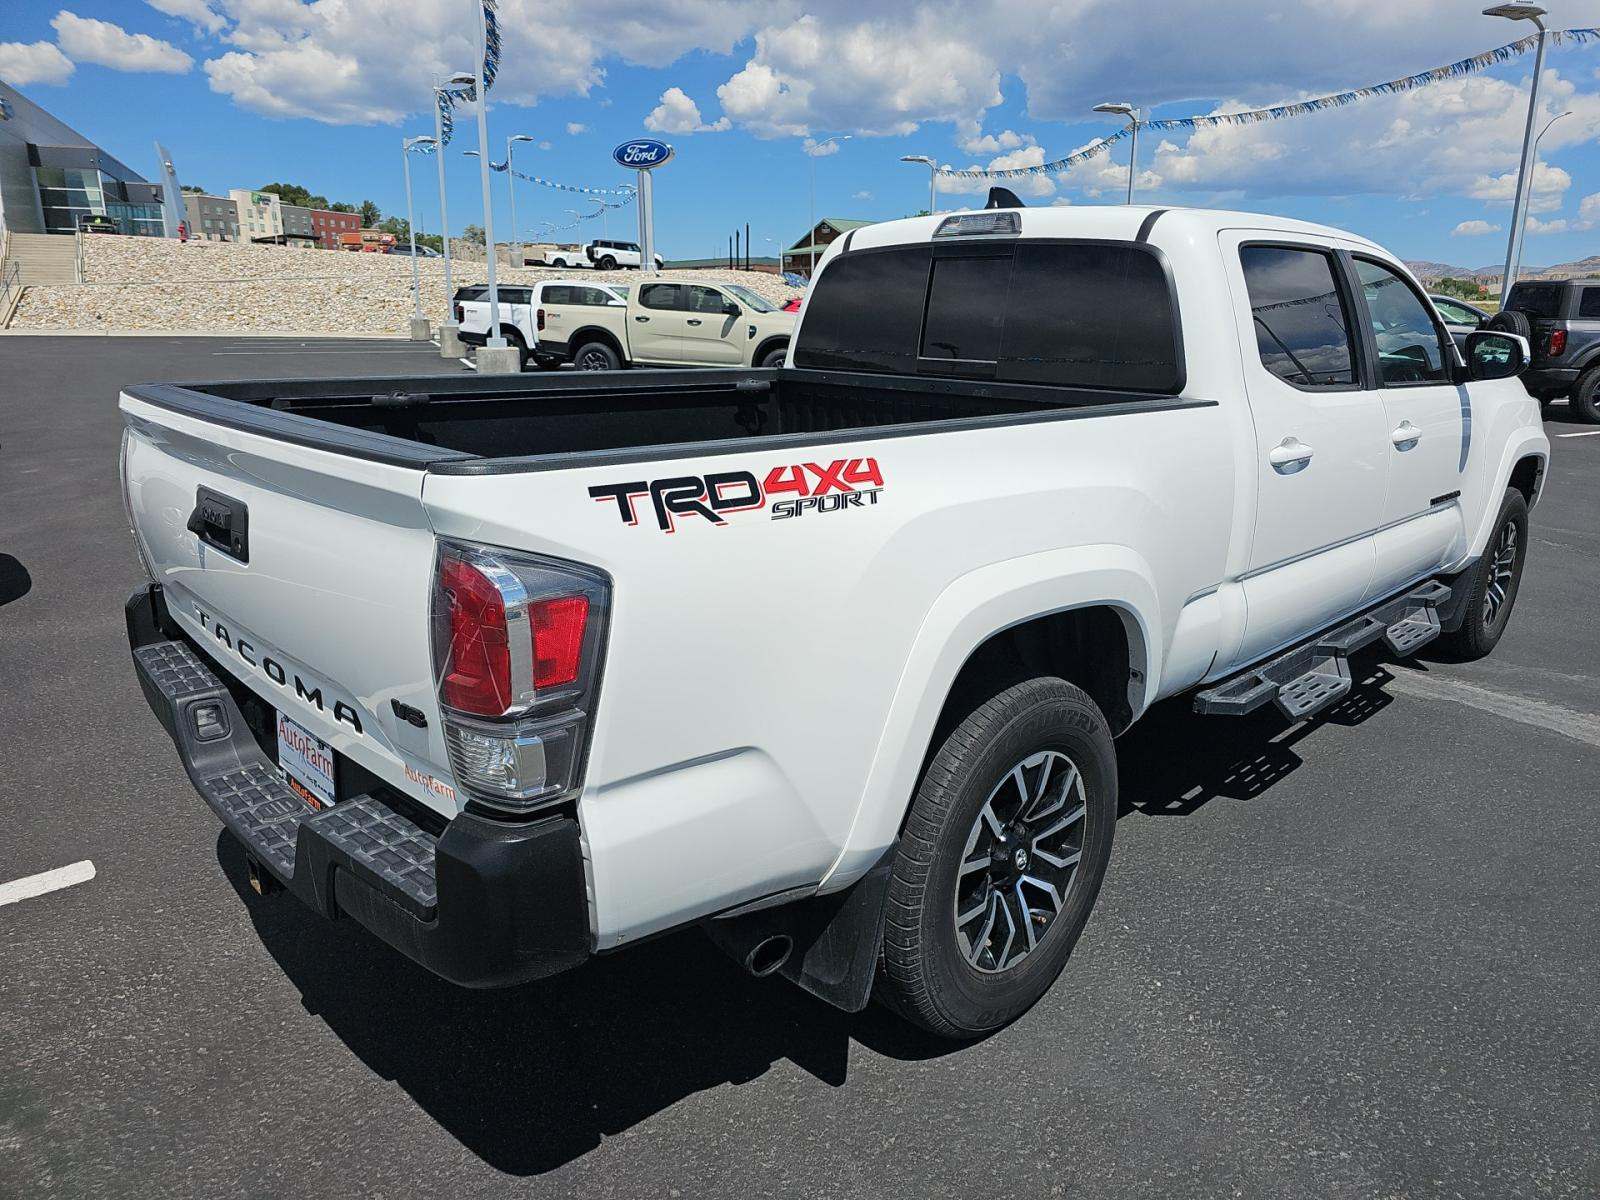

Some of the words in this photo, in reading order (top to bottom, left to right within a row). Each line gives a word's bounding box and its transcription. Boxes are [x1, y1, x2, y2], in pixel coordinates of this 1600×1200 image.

[624, 144, 658, 162] Ford
[587, 470, 765, 534] TRD
[770, 487, 885, 520] SPORT
[193, 604, 364, 735] TACOMA
[278, 719, 334, 778] AutoFarm
[290, 777, 321, 811] AutoFarm
[404, 763, 457, 802] AutoFarm
